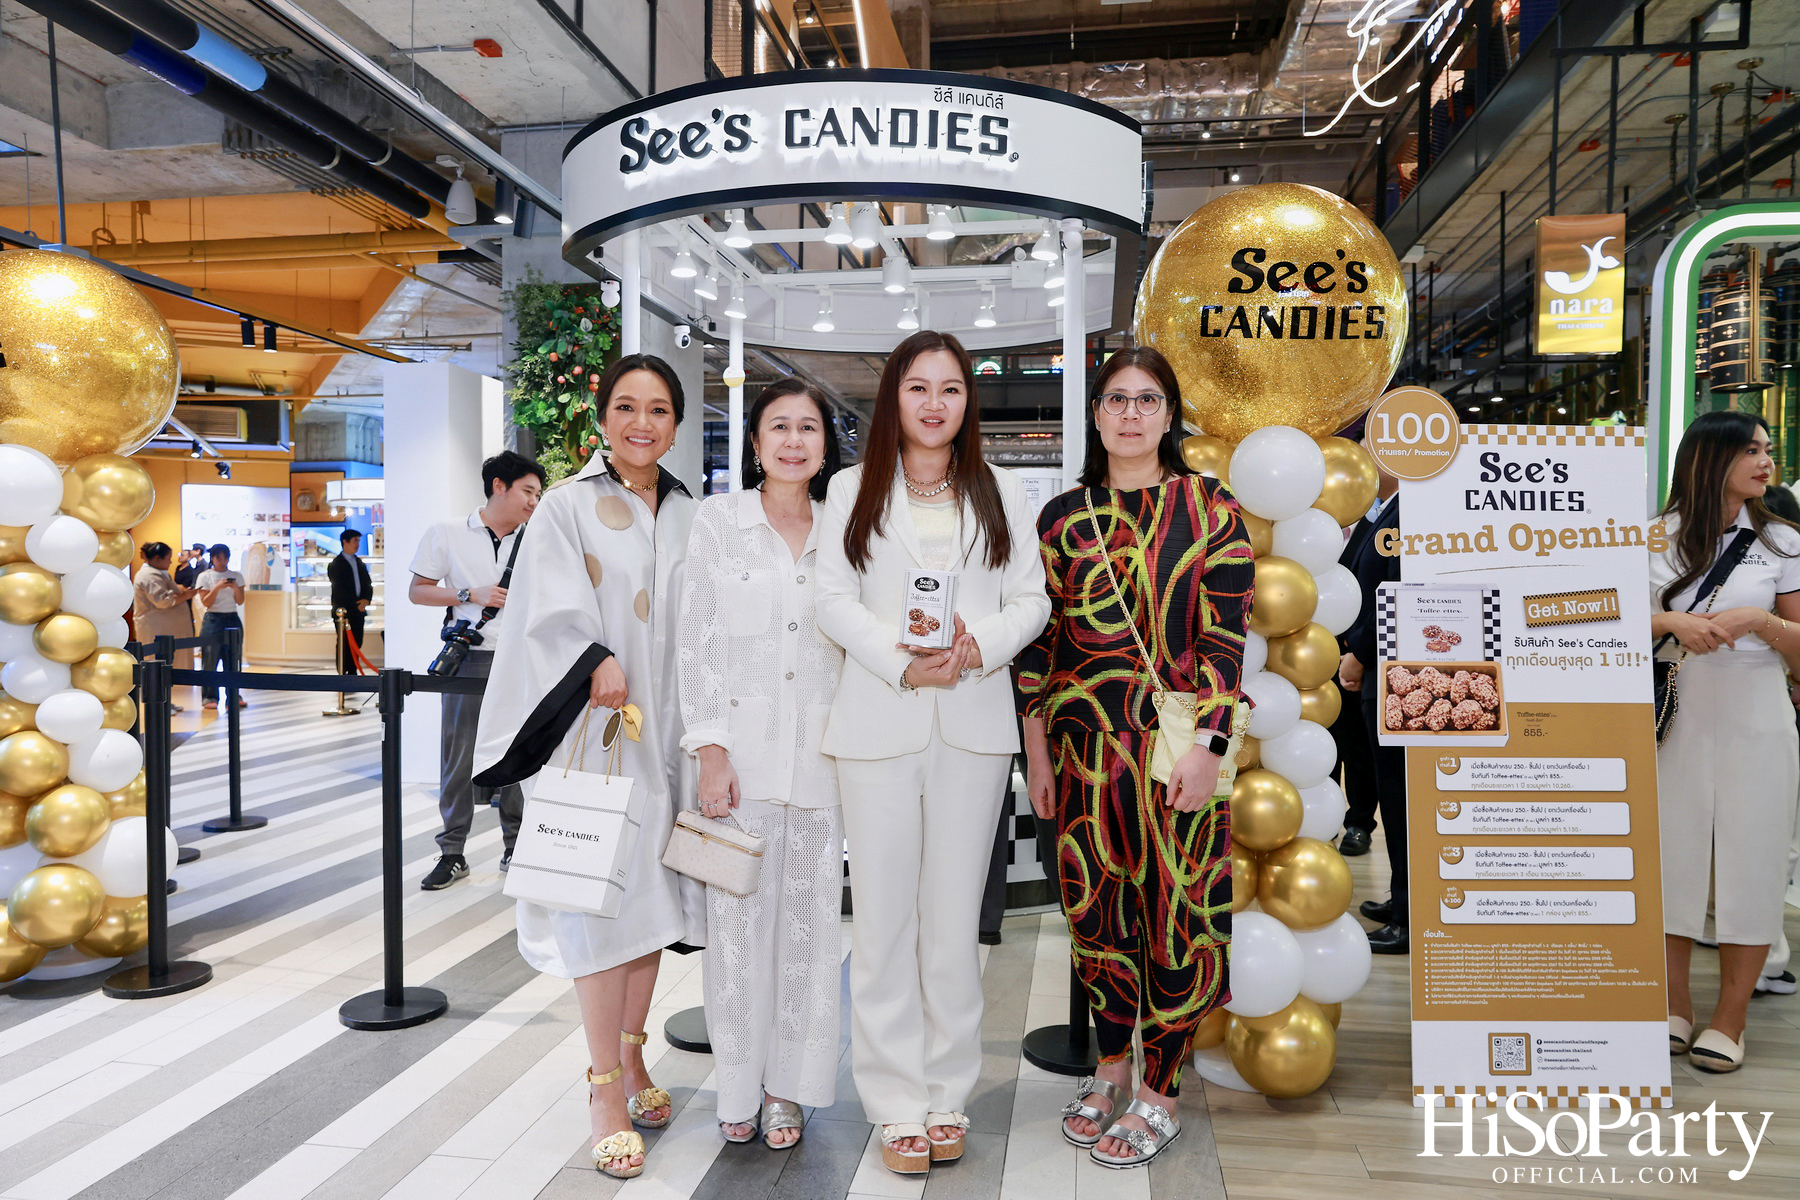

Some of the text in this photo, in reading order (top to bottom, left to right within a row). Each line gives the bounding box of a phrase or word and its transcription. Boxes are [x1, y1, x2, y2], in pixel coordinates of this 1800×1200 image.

[619, 108, 752, 175] See's
[1227, 247, 1369, 294] See's
[1550, 297, 1614, 315] nara
[1376, 412, 1451, 445] 100
[1414, 448, 1450, 456] Promotion
[1479, 451, 1569, 484] See's
[1374, 518, 1670, 558] Grand Opening
[1527, 596, 1617, 619] Get Now!!
[1514, 636, 1628, 648] รับสินค้า See's Candies
[1506, 652, 1593, 671] ทุกเดือนสูงสุด
[1600, 652, 1610, 667] 1
[1523, 728, 1549, 737] 855.-
[1450, 757, 1457, 768] 1
[1450, 802, 1458, 812] 2
[537, 823, 600, 843] See's CANDIES
[1453, 847, 1461, 857] 3
